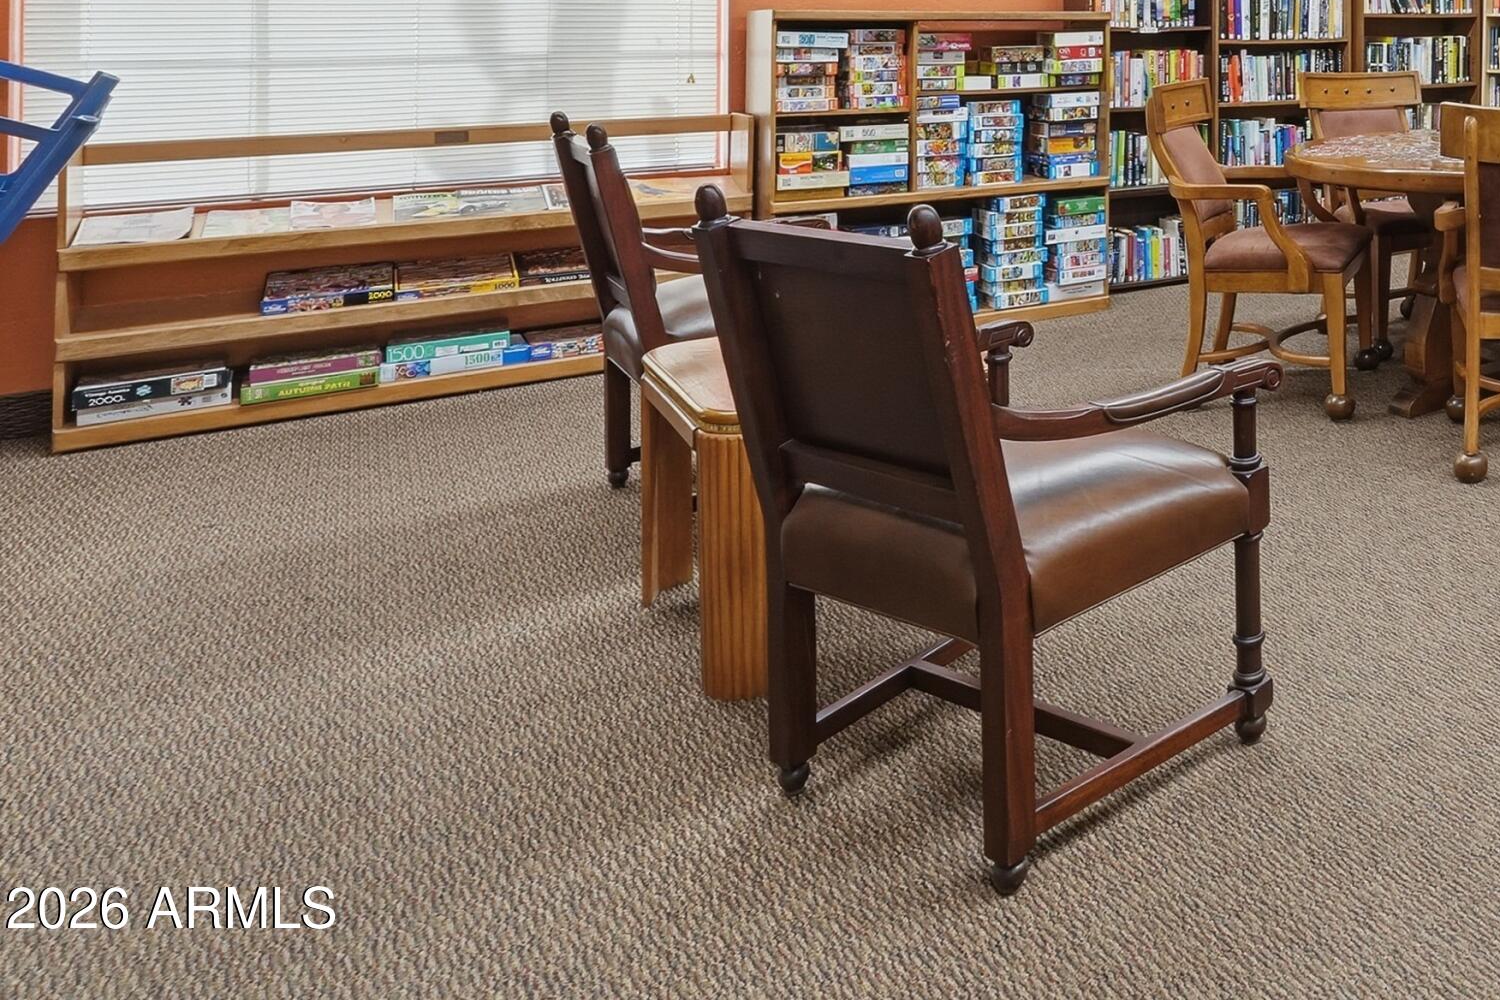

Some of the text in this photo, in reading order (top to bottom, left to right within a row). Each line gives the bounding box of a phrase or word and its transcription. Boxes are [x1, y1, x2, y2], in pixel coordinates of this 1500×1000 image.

[494, 281, 516, 290] 1000
[368, 290, 393, 301] 2000
[387, 344, 425, 362] 1500
[464, 353, 490, 366] 1500
[278, 381, 351, 397] AUTUMN PATH
[88, 394, 123, 407] 2000
